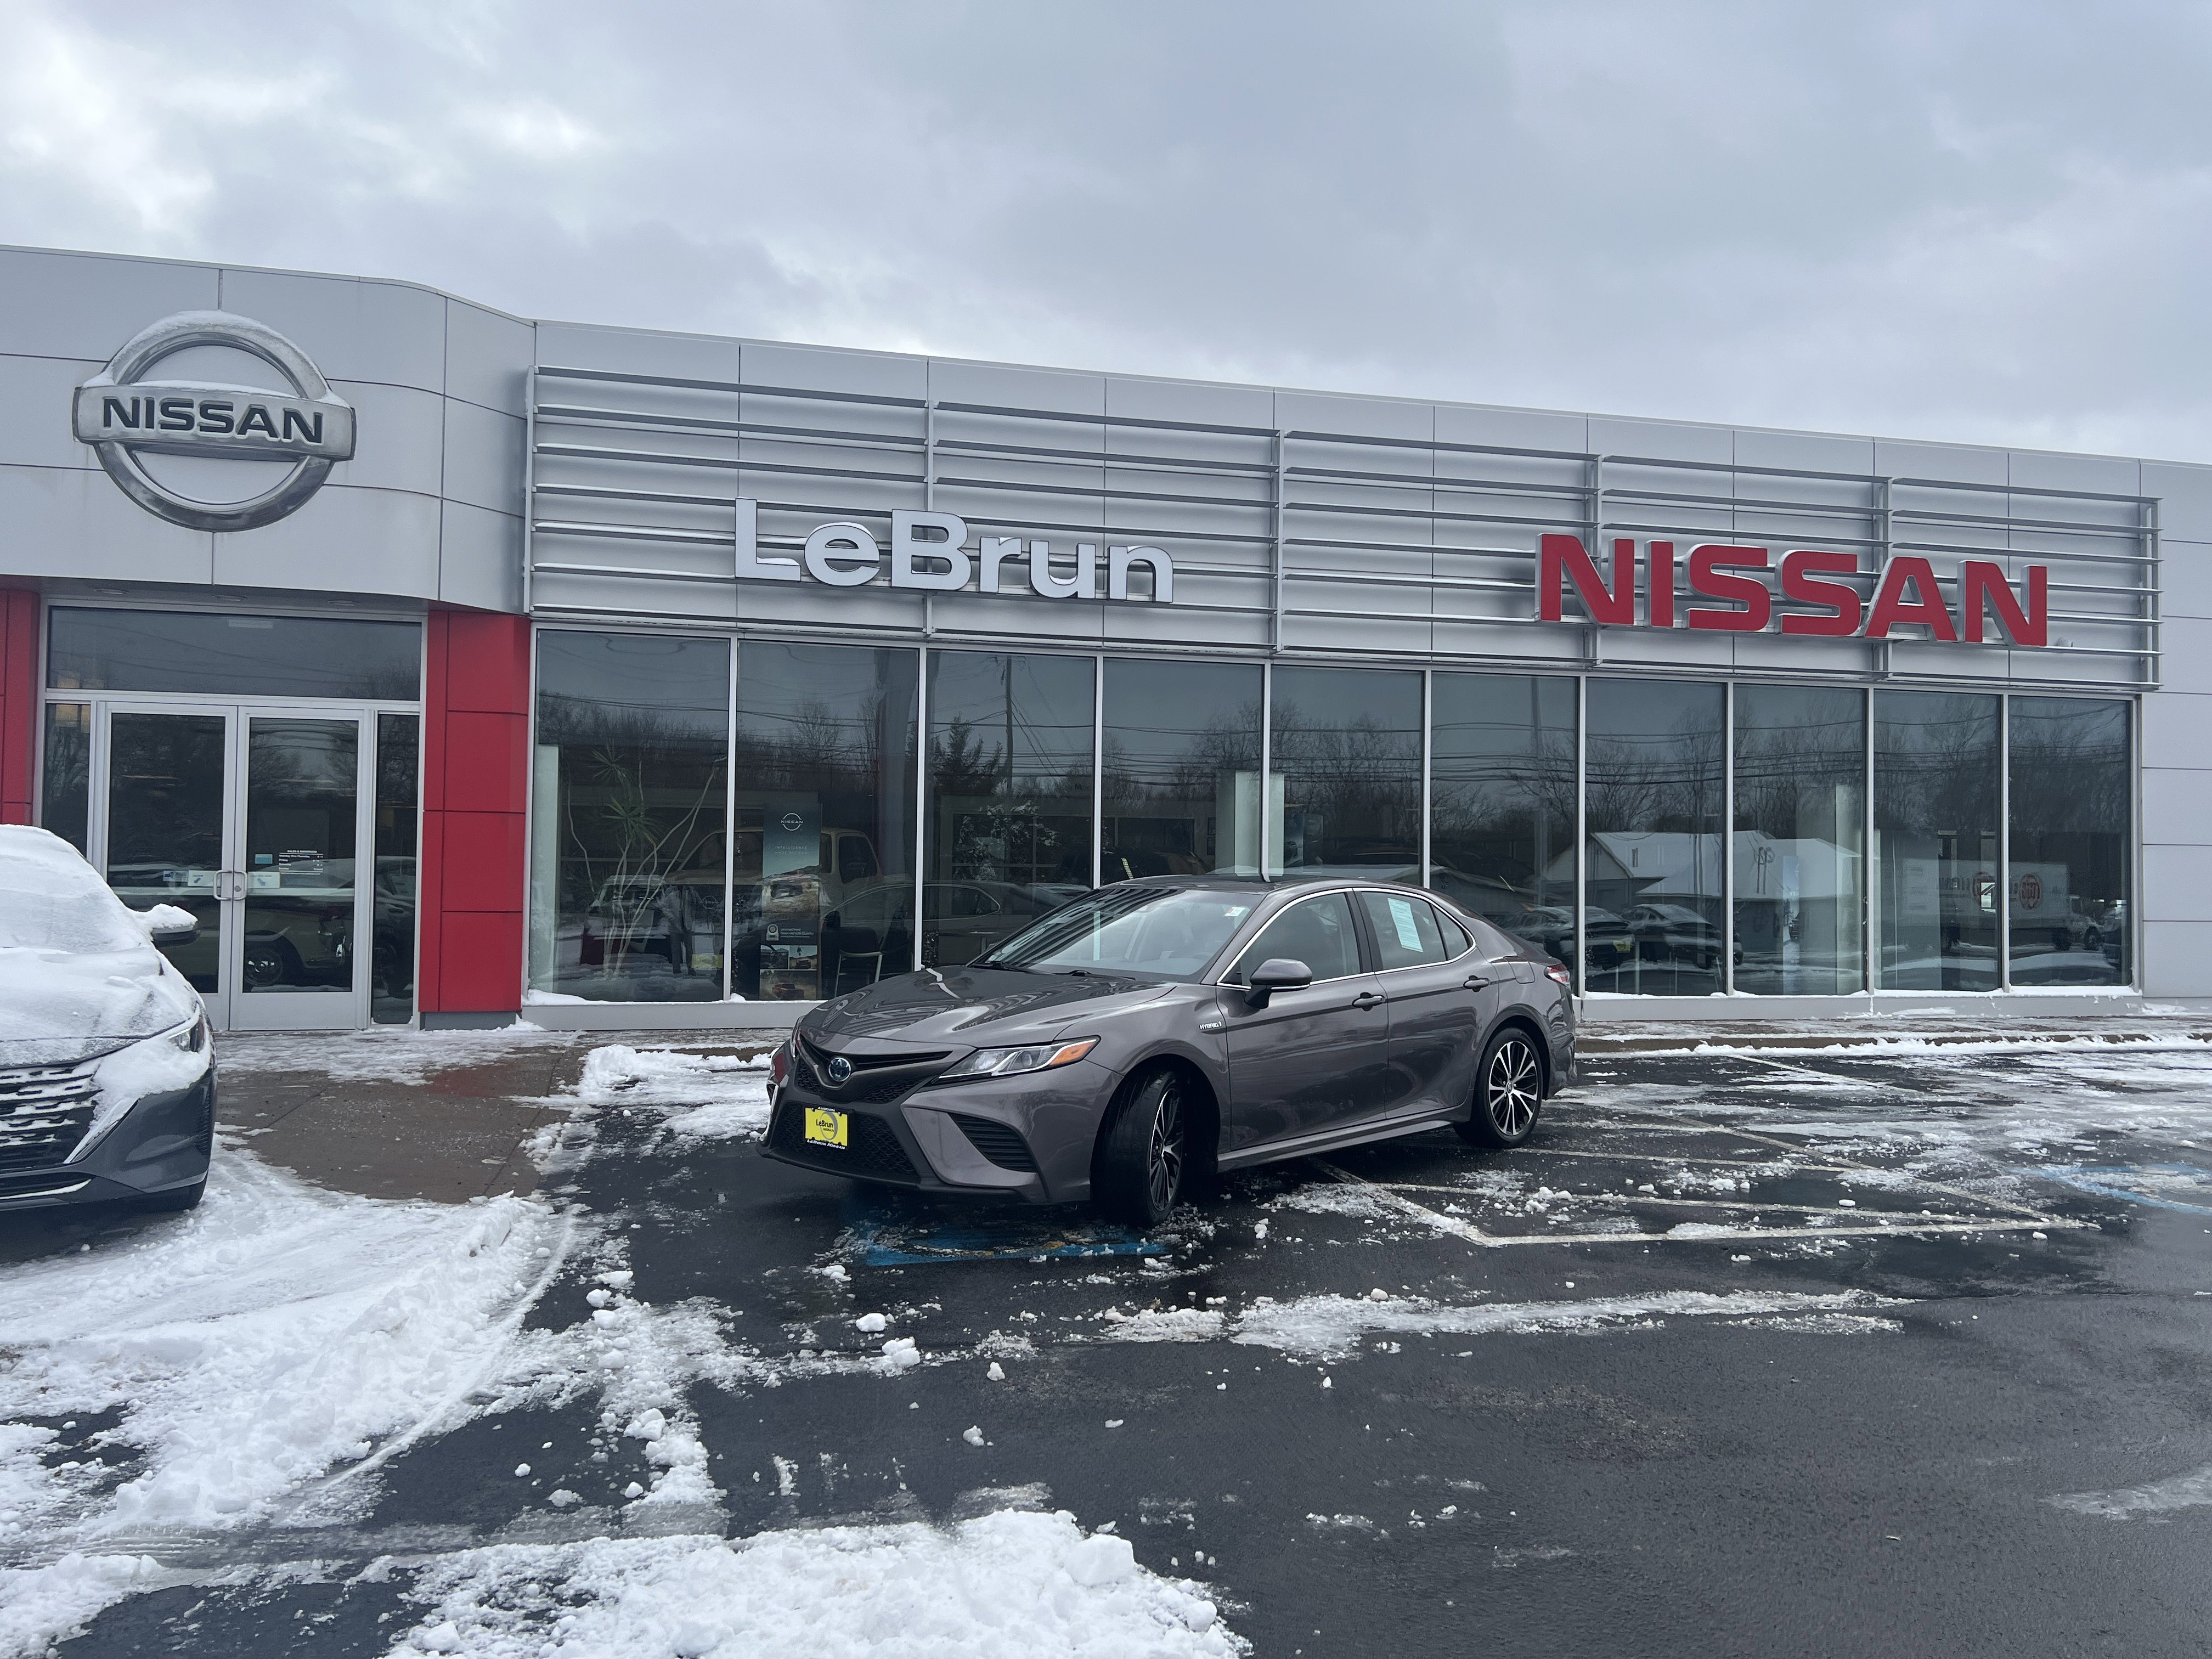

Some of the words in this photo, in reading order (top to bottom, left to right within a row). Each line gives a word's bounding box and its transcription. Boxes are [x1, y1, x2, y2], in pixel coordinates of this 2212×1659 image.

[103, 397, 324, 444] NISSAN
[735, 496, 1174, 603] LeBrun
[1537, 533, 2047, 647] NISSAN
[1199, 1021, 1222, 1030] HYBRID
[816, 1119, 833, 1128] LeBrun
